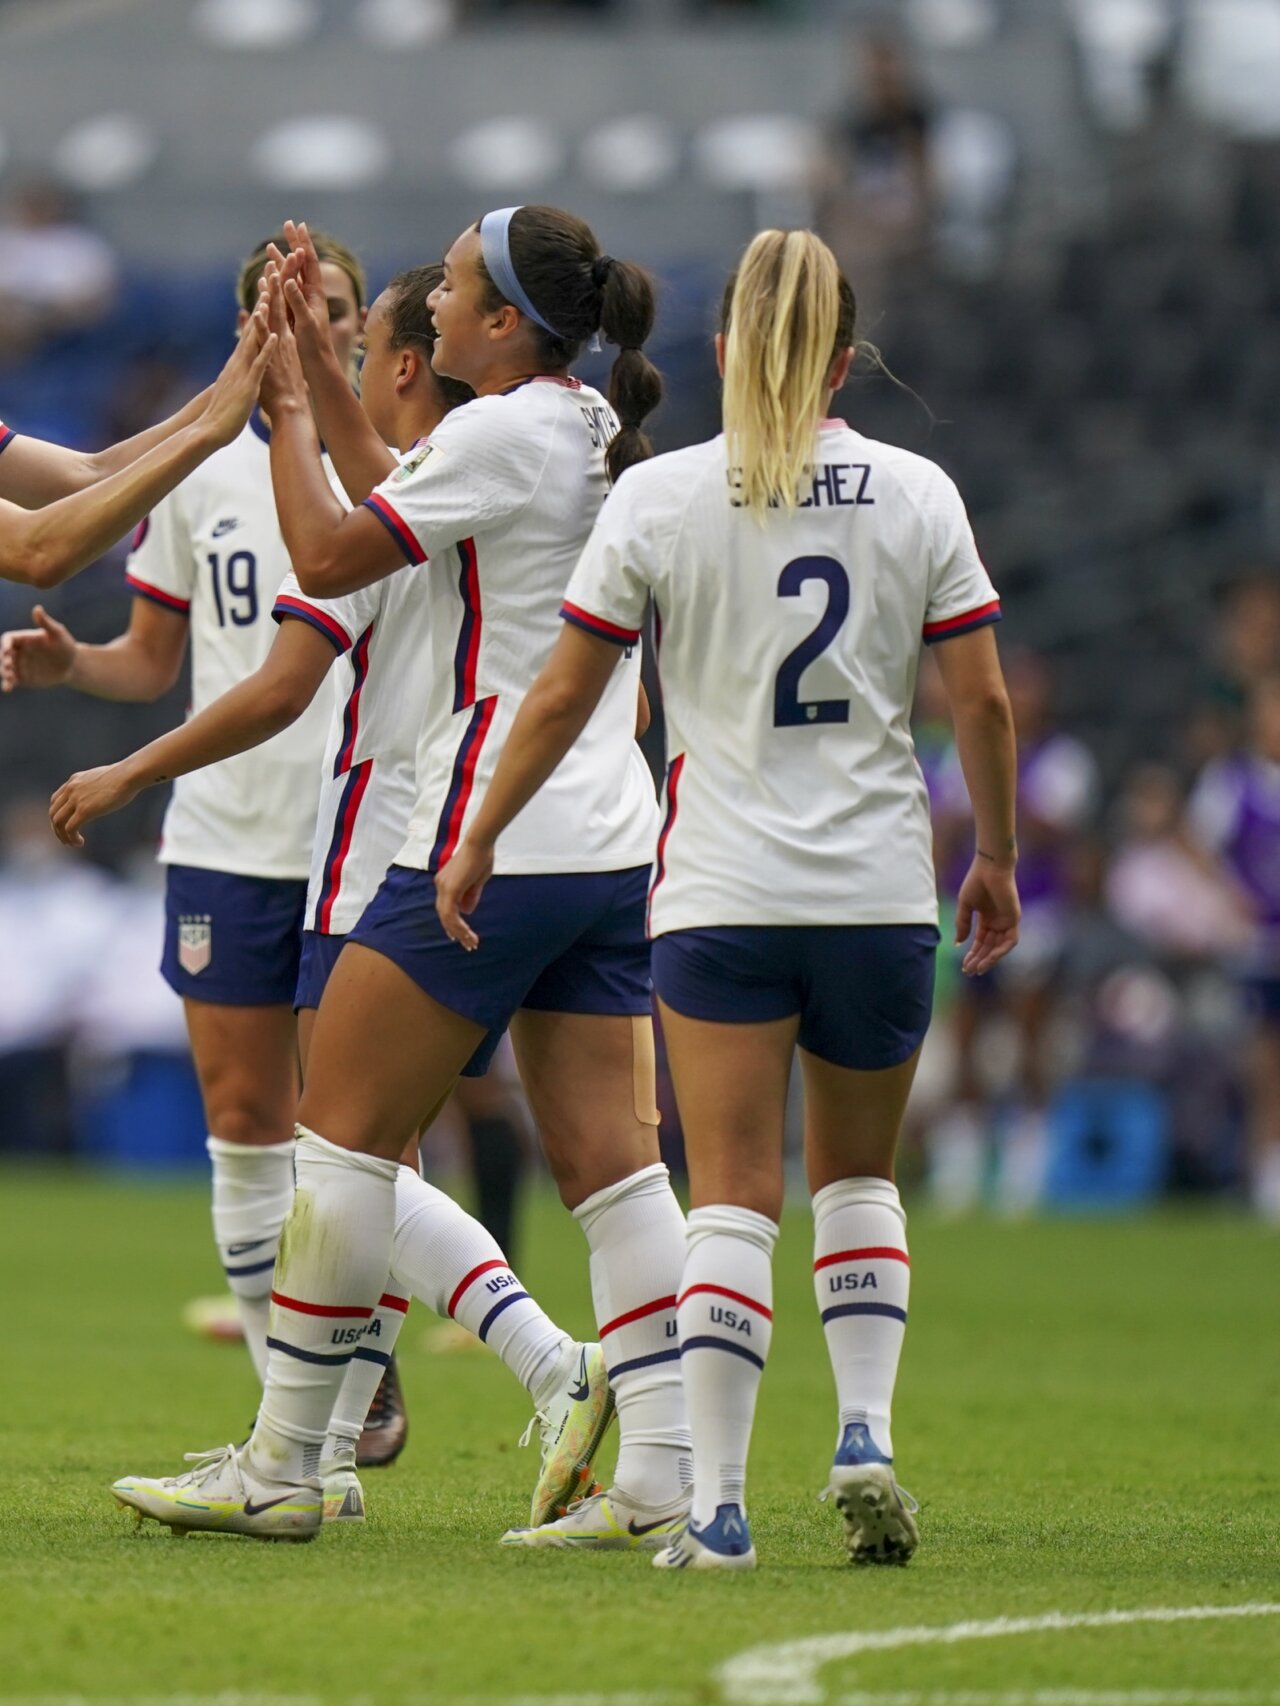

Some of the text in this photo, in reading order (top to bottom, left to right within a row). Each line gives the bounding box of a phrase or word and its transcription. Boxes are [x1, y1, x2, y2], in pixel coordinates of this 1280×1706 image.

[207, 550, 258, 627] 19
[774, 555, 850, 727] 2
[485, 1274, 518, 1294] USA
[829, 1271, 878, 1293] USA
[709, 1305, 753, 1337] USA
